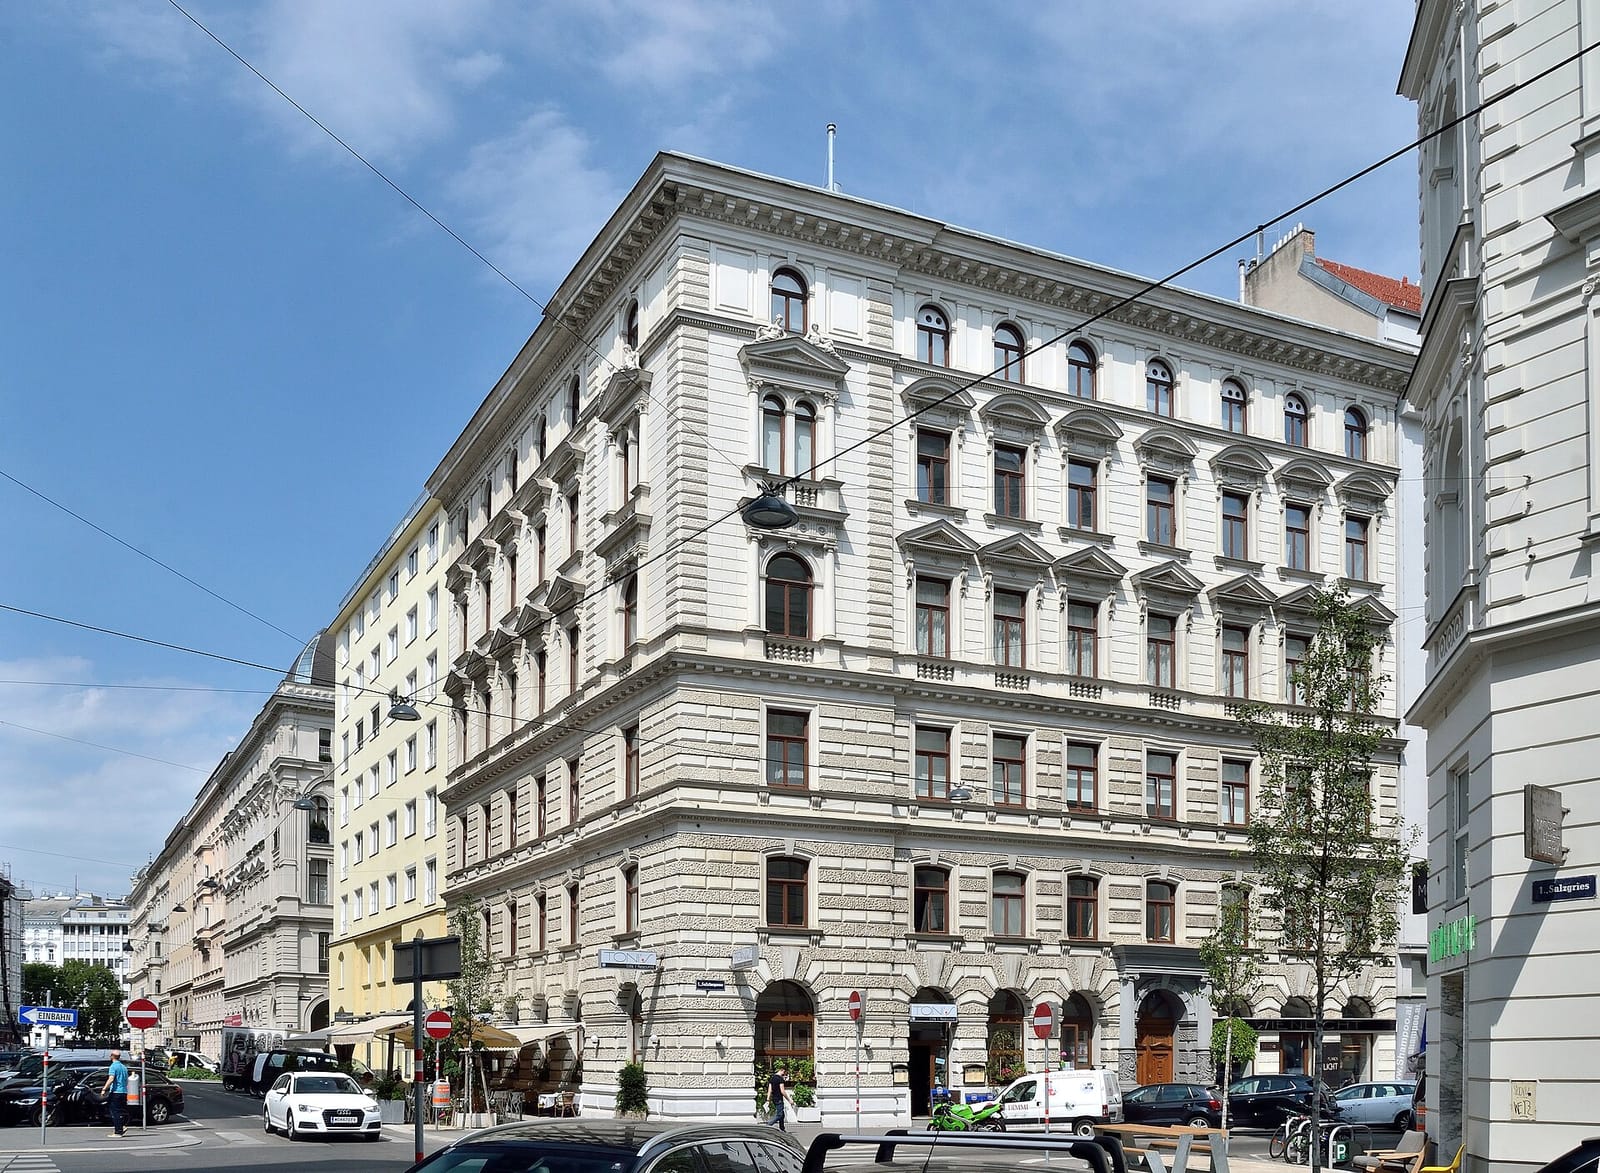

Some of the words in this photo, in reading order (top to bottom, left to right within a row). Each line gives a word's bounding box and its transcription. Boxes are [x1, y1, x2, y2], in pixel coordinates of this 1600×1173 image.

[38, 1012, 71, 1021] EINBAHN
[1256, 1020, 1361, 1030] WIENLCHT
[1337, 1144, 1346, 1160] P
